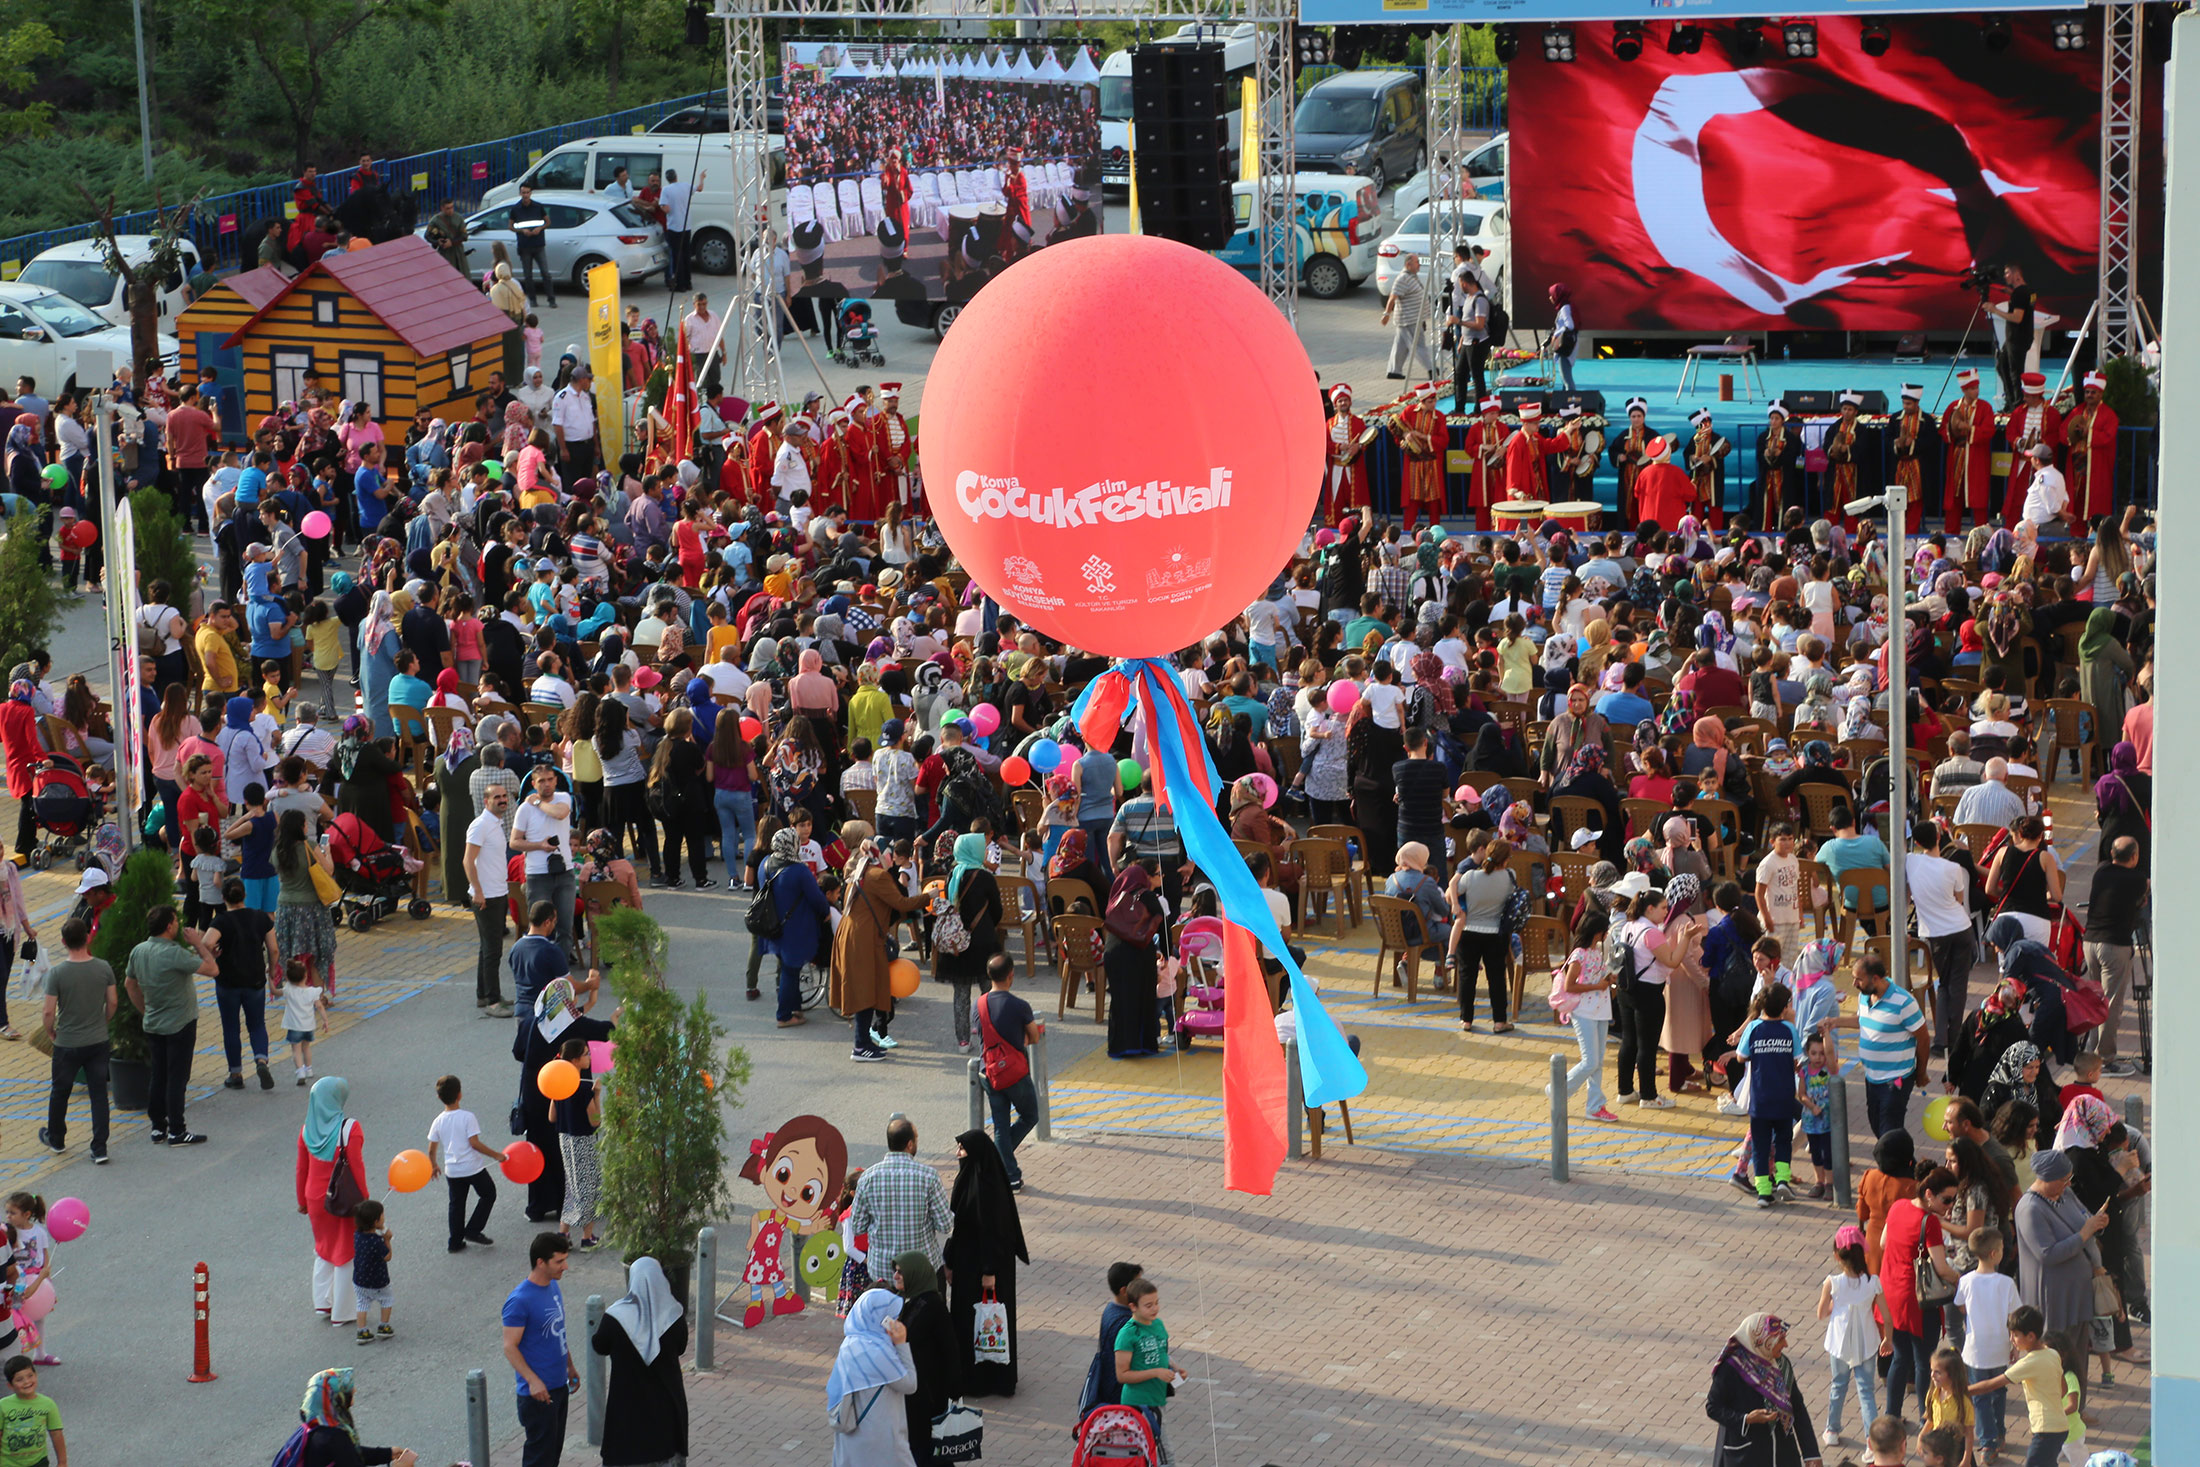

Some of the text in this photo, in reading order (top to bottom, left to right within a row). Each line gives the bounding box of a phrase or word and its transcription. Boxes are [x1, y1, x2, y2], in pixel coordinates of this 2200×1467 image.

[980, 475, 1019, 489] Konya
[1012, 584, 1045, 595] KONYA
[111, 637, 121, 651] 2
[1754, 1038, 1793, 1048] SELÇUKLU
